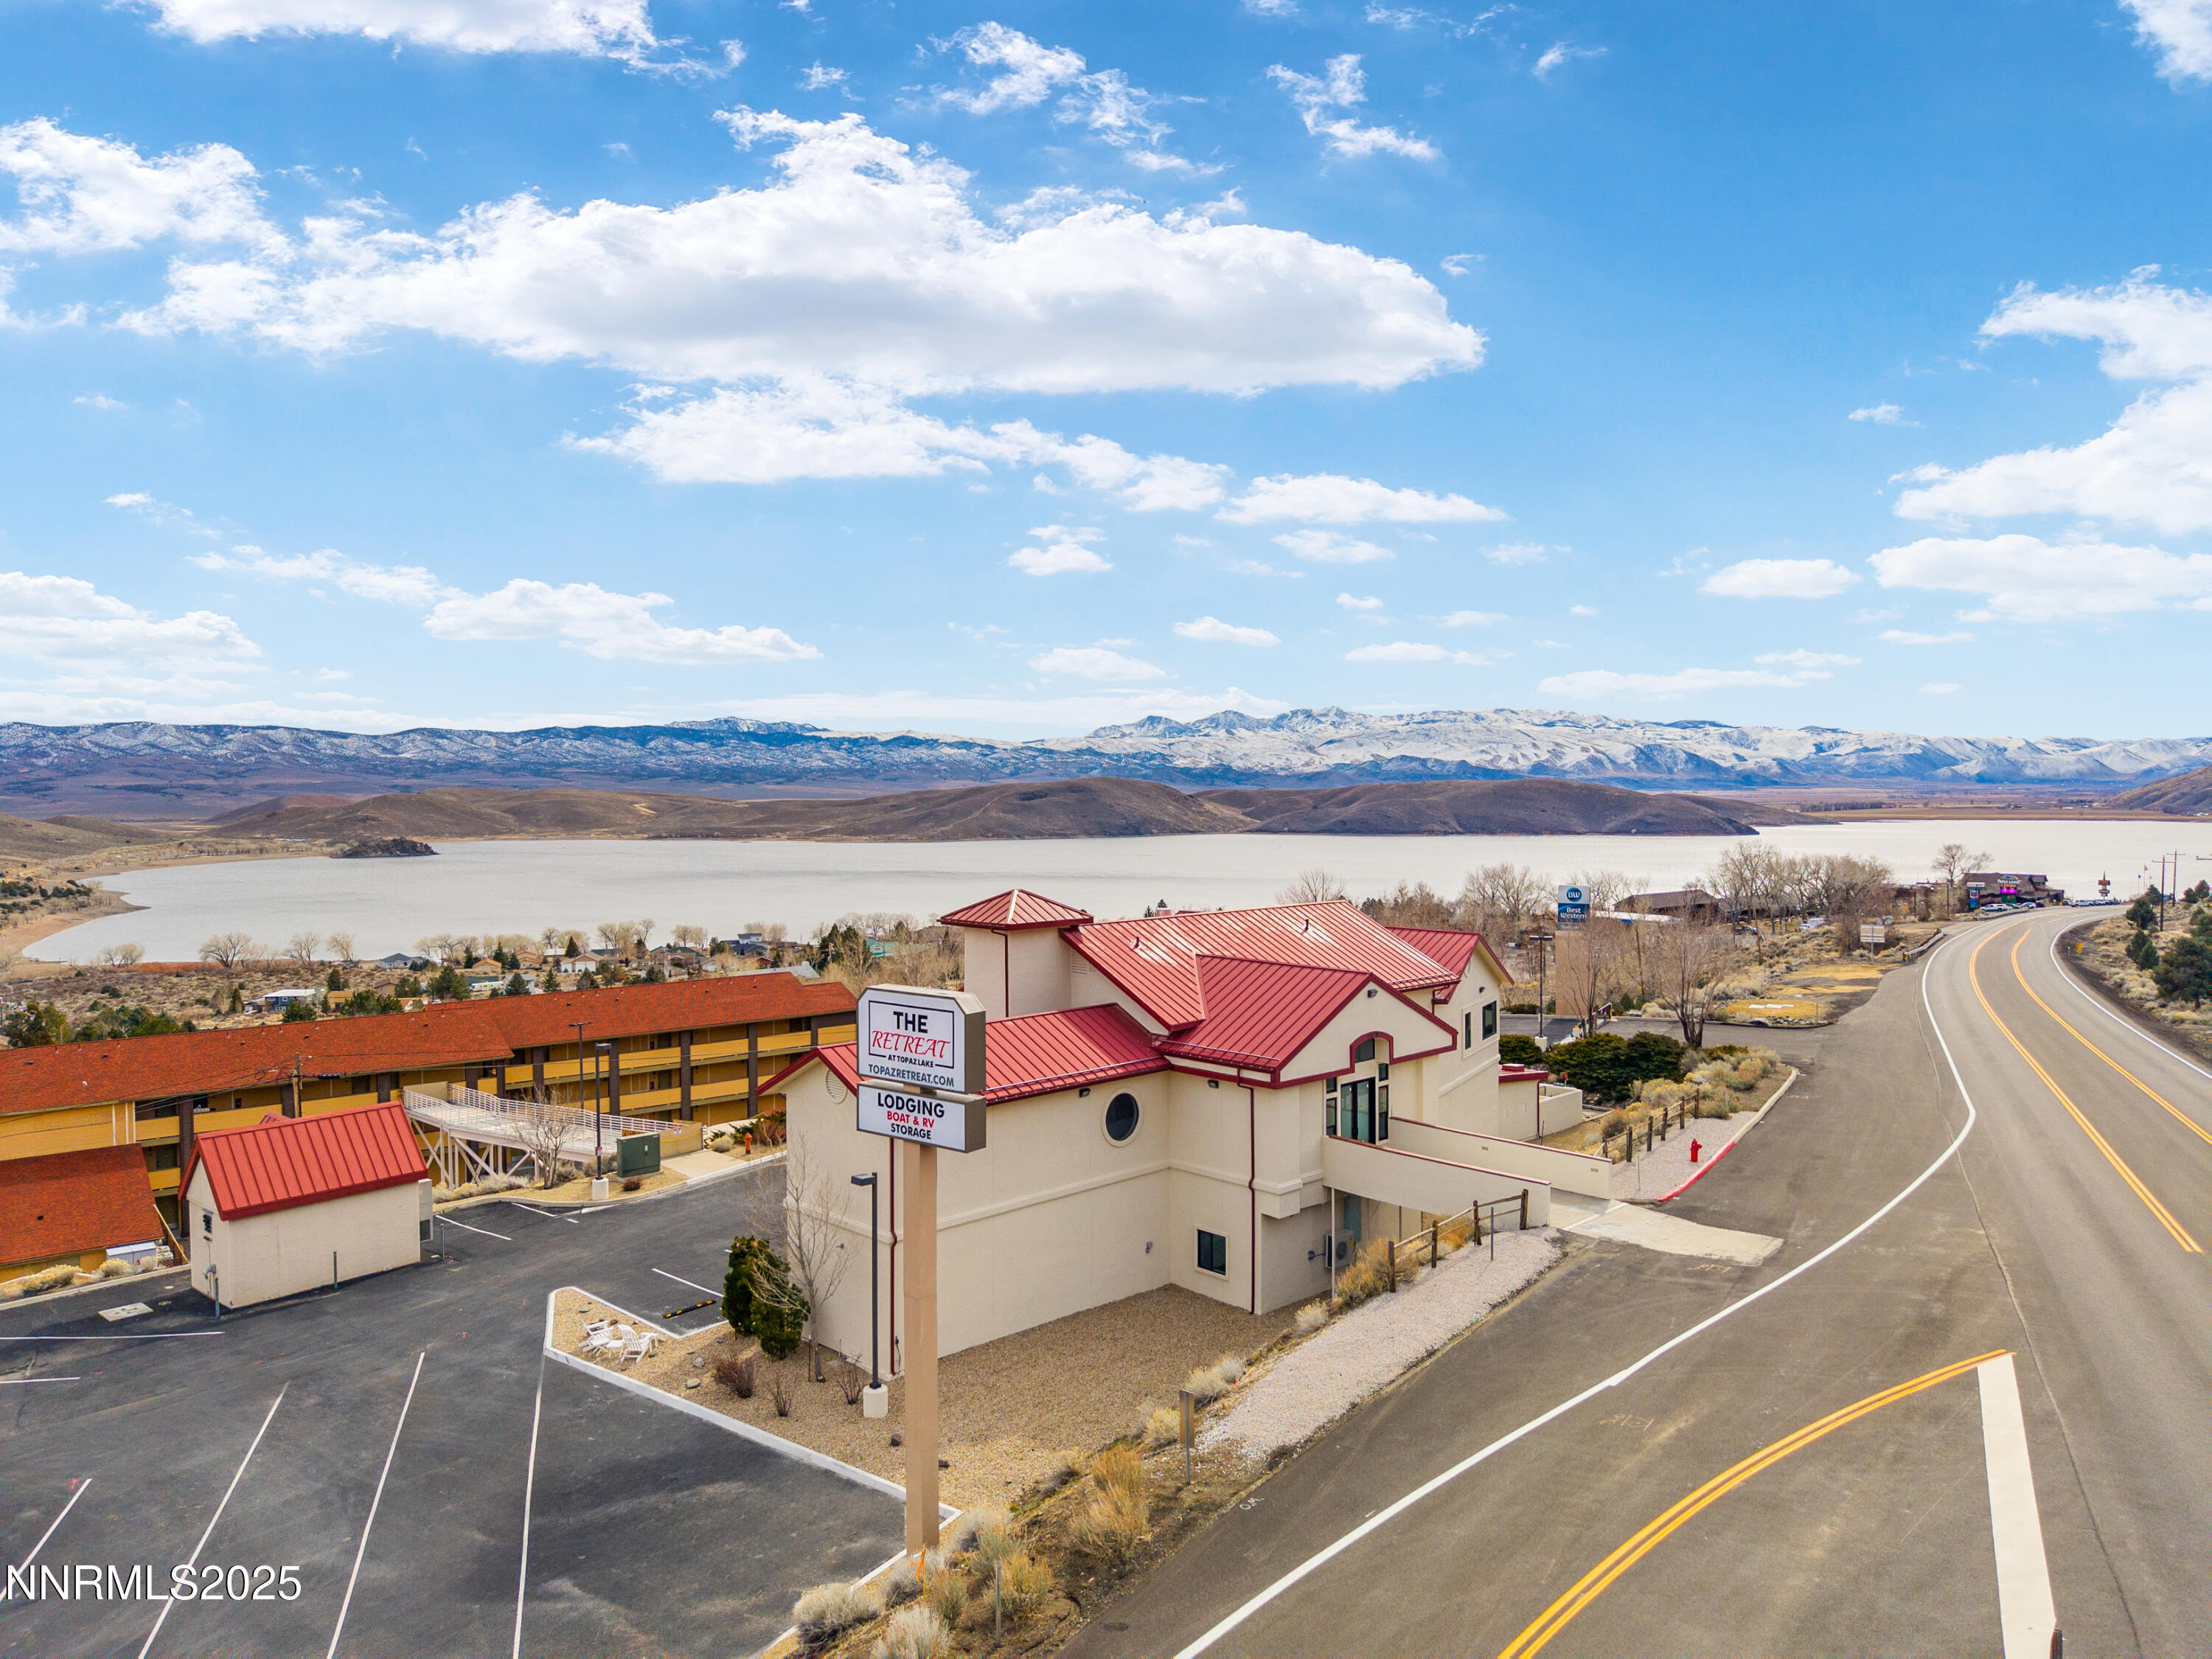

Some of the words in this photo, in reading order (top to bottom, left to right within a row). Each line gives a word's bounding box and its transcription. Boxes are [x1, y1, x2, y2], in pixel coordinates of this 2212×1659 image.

[893, 1011, 928, 1034] THE
[872, 1030, 950, 1058] RETREAT
[897, 1056, 917, 1065] TOPAZ
[918, 1059, 934, 1068] LAKE
[868, 1064, 954, 1088] TOPAZRETREAT.COM
[878, 1092, 945, 1118] LODGING
[887, 1110, 910, 1124] BOAT
[913, 1116, 919, 1126] &
[922, 1117, 934, 1128] RV
[891, 1123, 932, 1139] STORAGE
